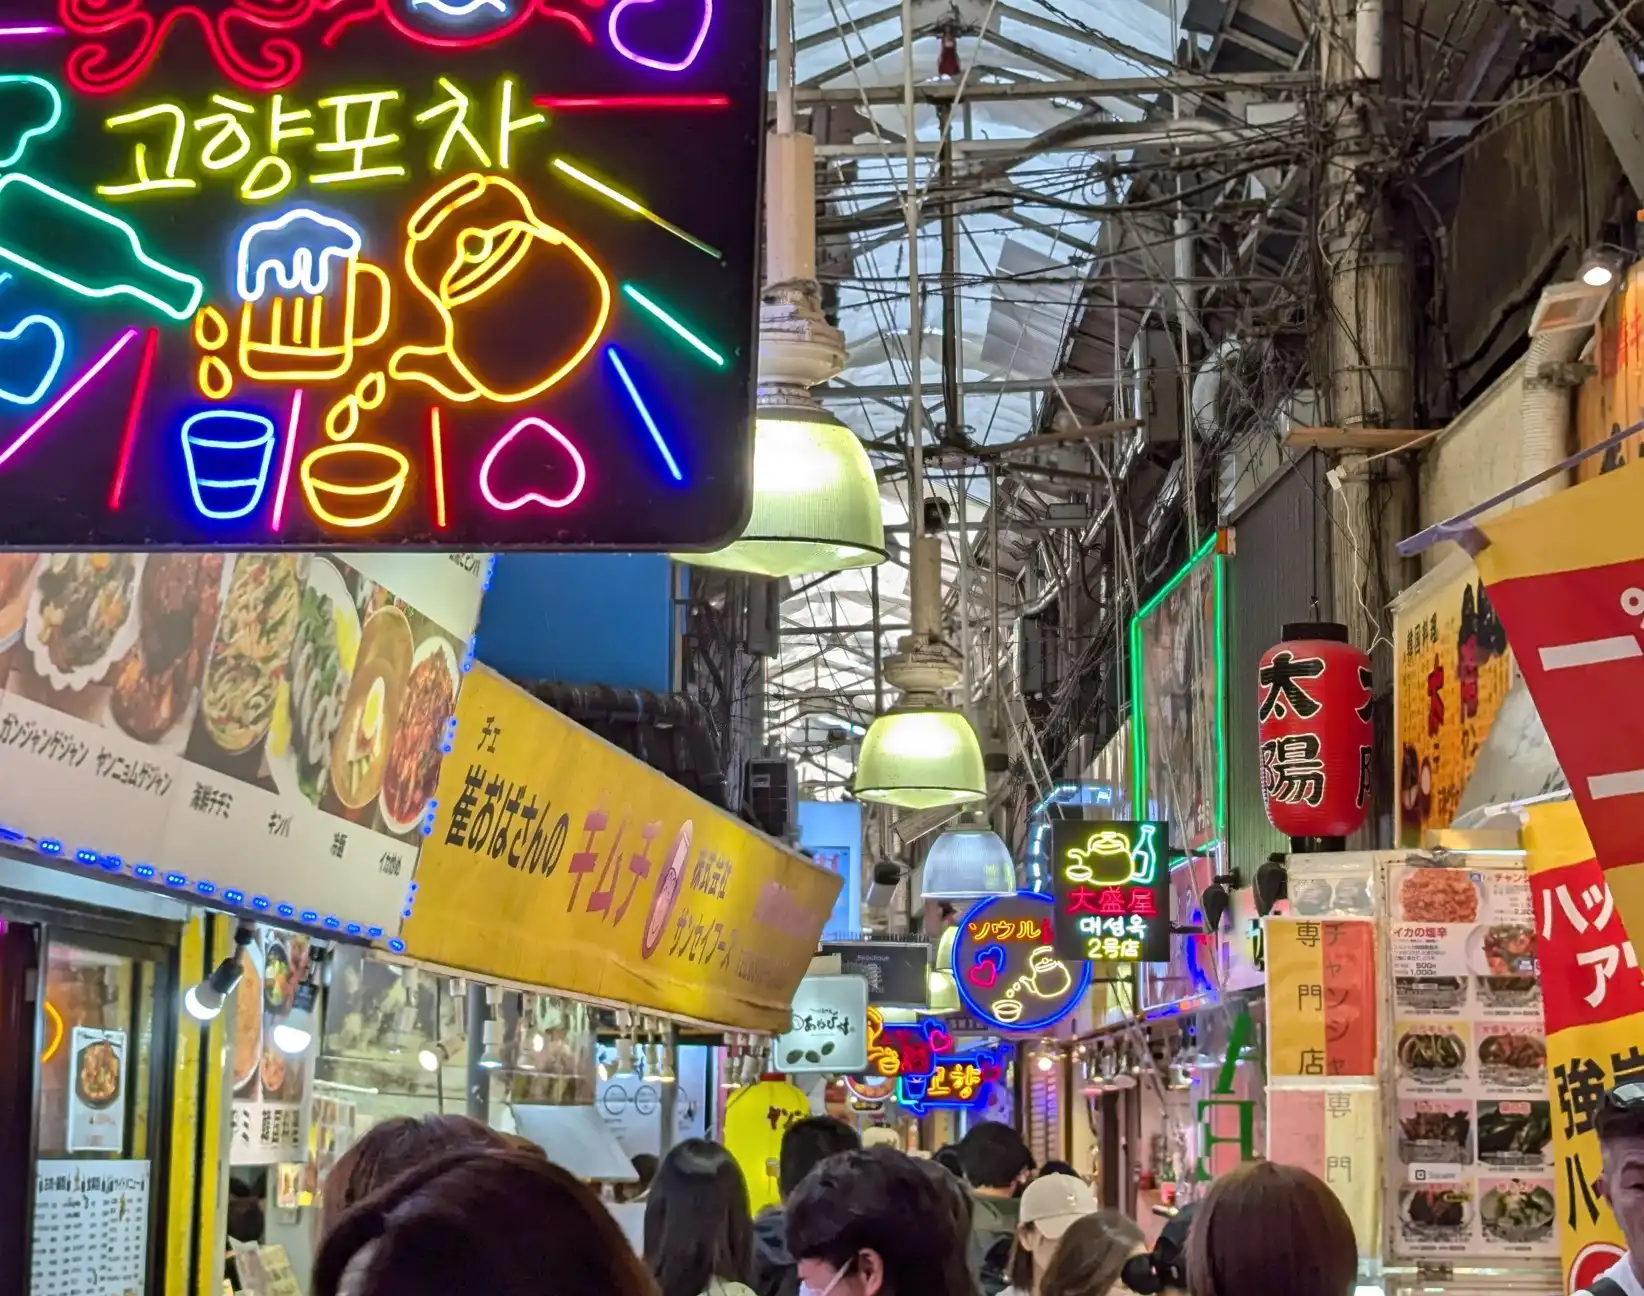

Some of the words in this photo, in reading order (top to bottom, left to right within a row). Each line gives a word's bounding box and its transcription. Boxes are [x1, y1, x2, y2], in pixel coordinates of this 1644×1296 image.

[96, 76, 545, 200] 고향포차
[477, 716, 501, 753] チェ
[1258, 650, 1327, 808] 太陽
[444, 764, 570, 879] 崔おばさんの
[566, 794, 663, 928] キムチ
[1067, 886, 1158, 914] 大盛屋
[968, 920, 1042, 941] ソウル
[1079, 915, 1148, 939] 대성옥
[1087, 937, 1141, 960] 2号店
[1393, 926, 1448, 939] イカの塩辛
[1296, 920, 1325, 1076] 専門店
[1325, 921, 1350, 1076] チャンジャ
[1577, 941, 1644, 1008] ア
[927, 1064, 982, 1099] 고향
[1326, 1091, 1352, 1184] 専門
